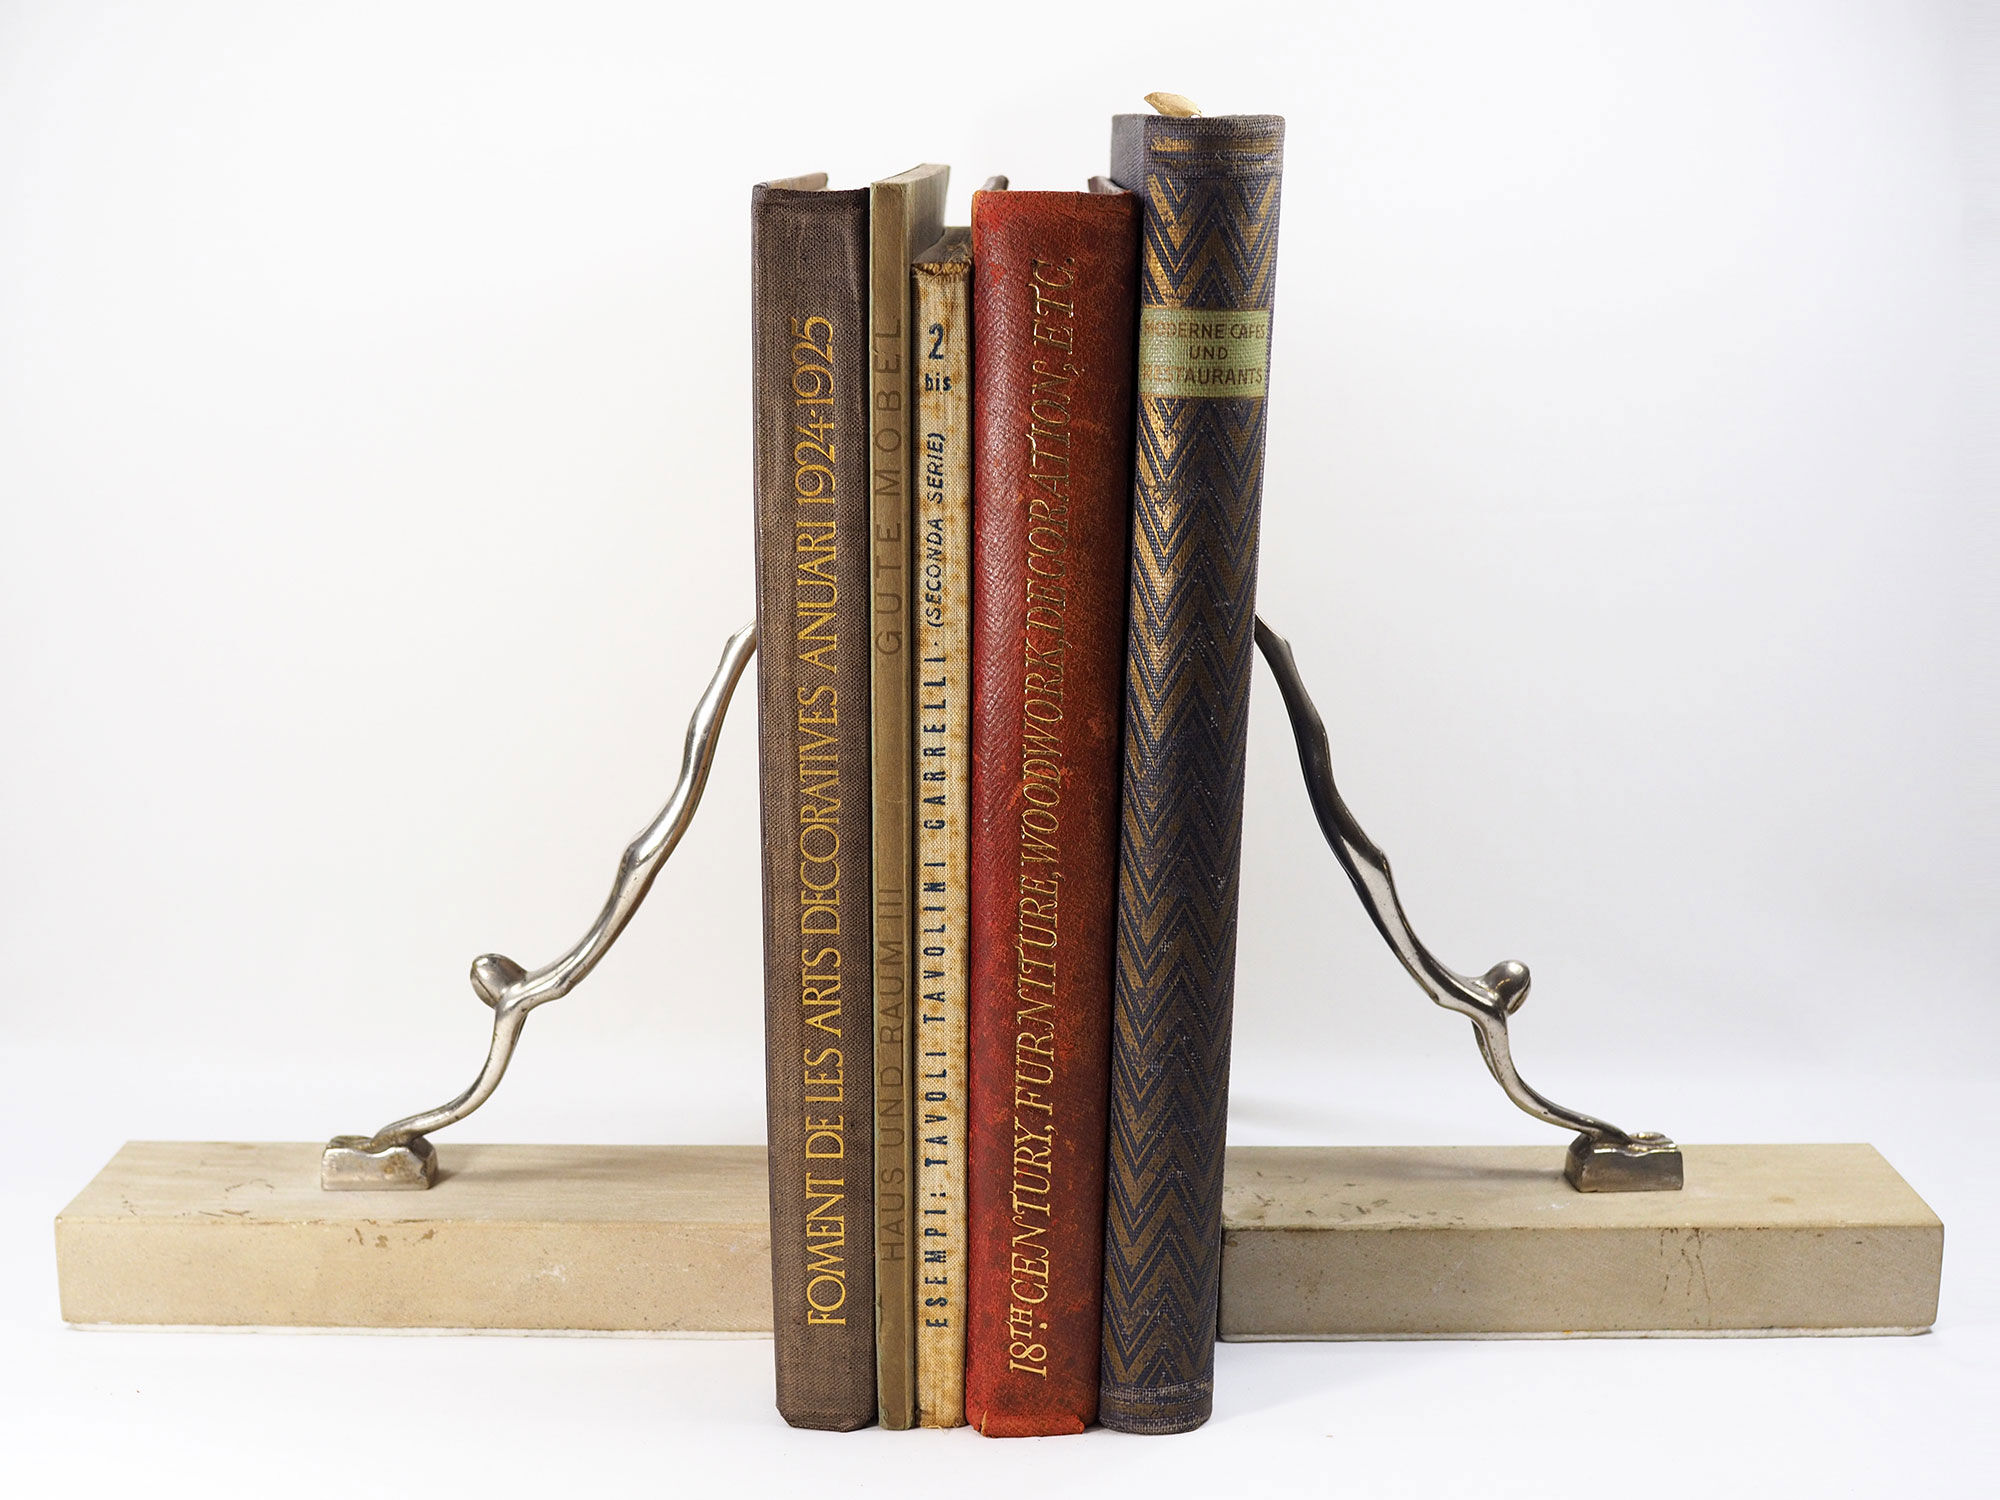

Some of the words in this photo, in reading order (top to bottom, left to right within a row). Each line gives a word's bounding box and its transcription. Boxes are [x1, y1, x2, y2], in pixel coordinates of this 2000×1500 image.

[925, 373, 952, 393] bis
[928, 322, 945, 360] 2
[1142, 362, 1263, 385] RESTAURANTS
[1143, 320, 1225, 340] MODERNE
[1189, 345, 1228, 361] UND
[791, 316, 836, 506] 1924-1925
[926, 432, 946, 505] SERIE)
[1025, 363, 1080, 638] DECORATION,
[794, 521, 838, 674] ANUARI
[874, 522, 903, 655] GUTE
[925, 517, 945, 628] (SECONDA
[1020, 639, 1073, 866] WOODWORK,
[798, 684, 841, 935] DECORATIVES
[877, 887, 904, 920] III
[922, 861, 947, 1024] TAVOLINI
[800, 948, 841, 1038] ARTS
[877, 939, 904, 1045] RAUM
[1014, 871, 1065, 1116] FURNITURE,
[803, 1048, 844, 1102] LES
[878, 1064, 905, 1148] UND
[924, 1050, 948, 1167] TAVOLI
[805, 1115, 844, 1159] DE
[806, 1172, 846, 1326] FOMENT
[878, 1167, 906, 1263] HAUS
[924, 1191, 949, 1328] ESEMPI:
[1009, 1115, 1058, 1305] CENTURY,
